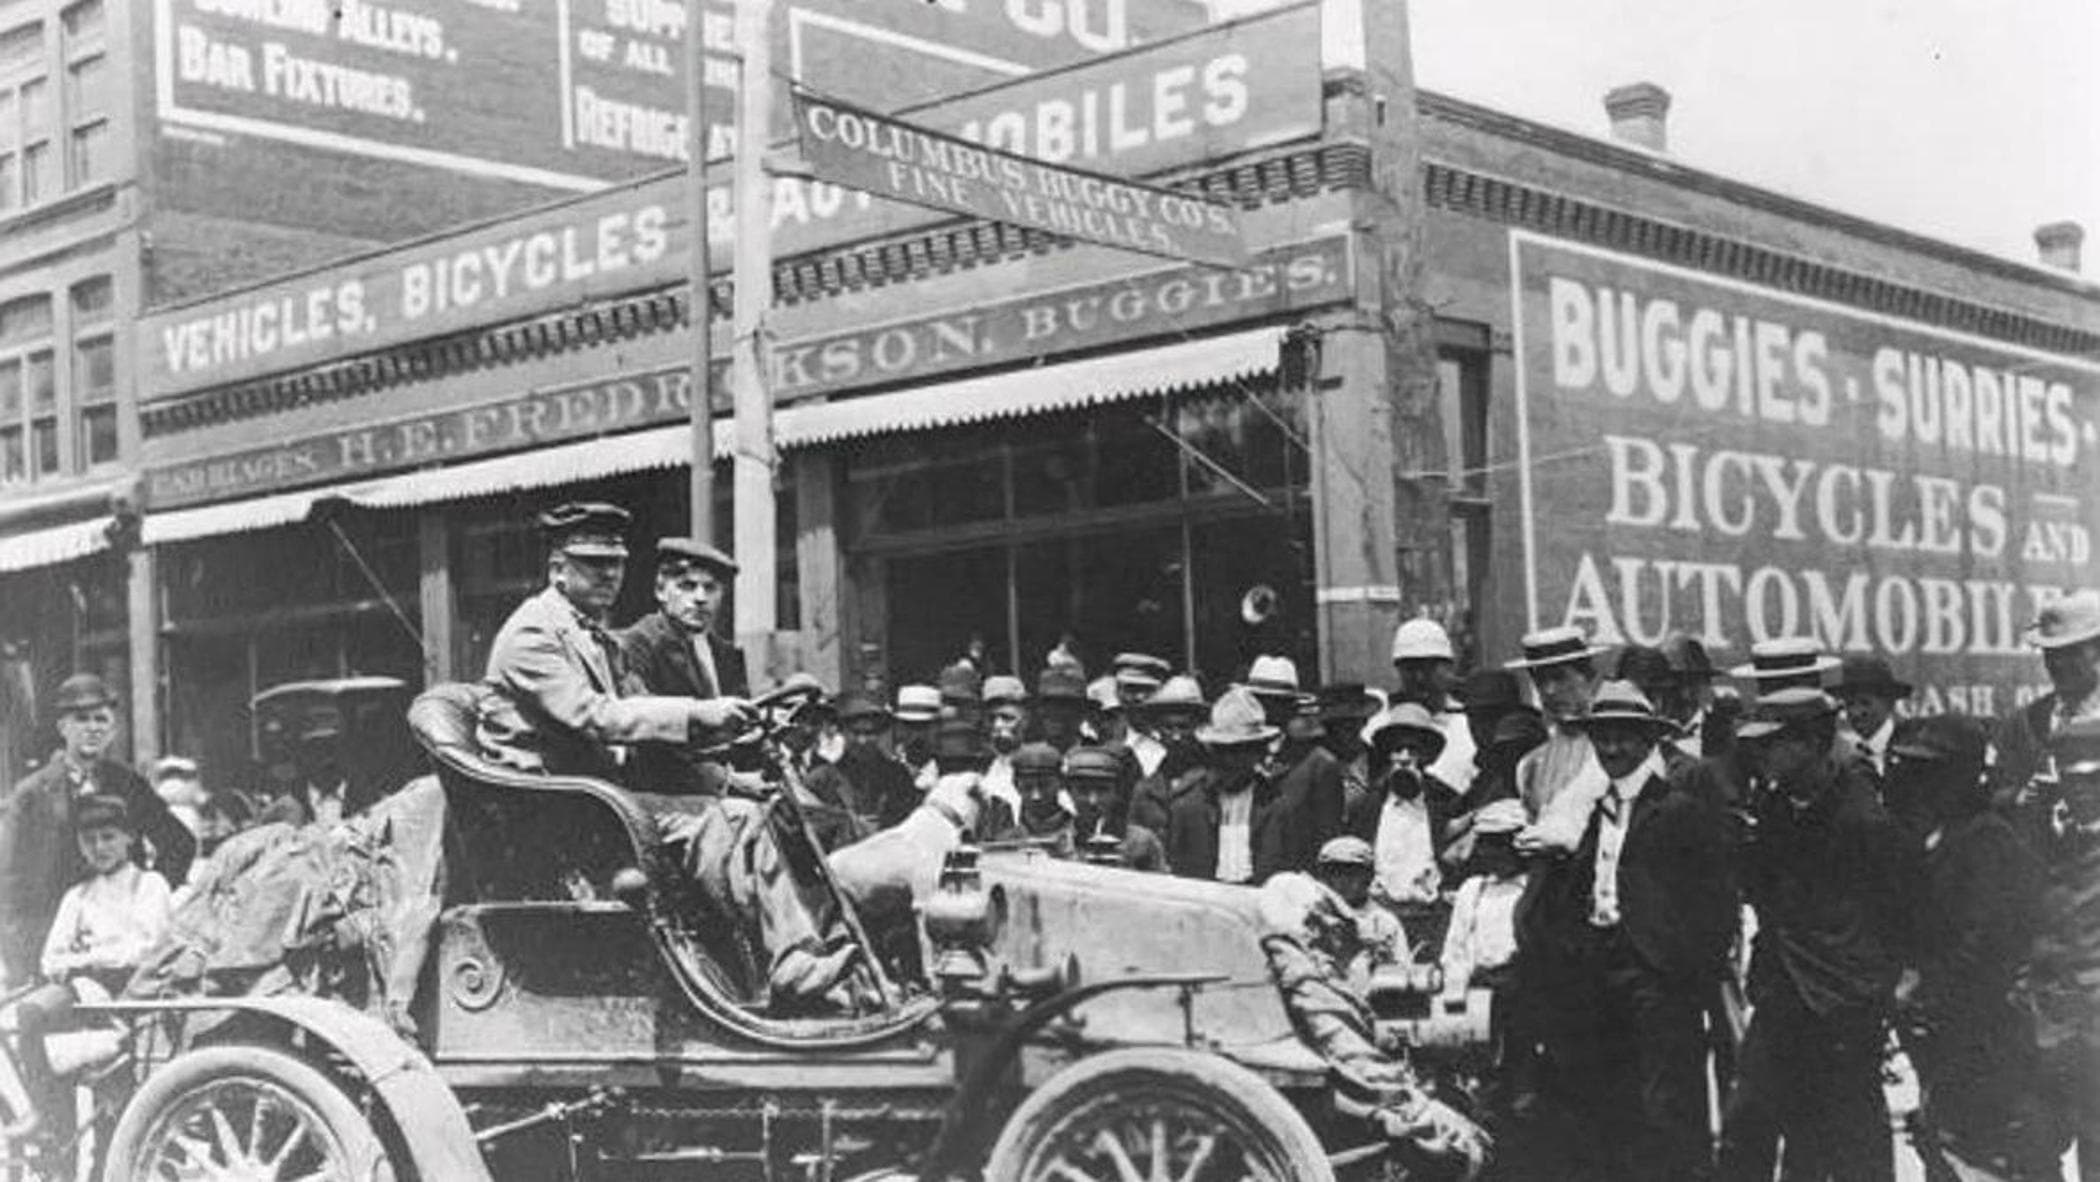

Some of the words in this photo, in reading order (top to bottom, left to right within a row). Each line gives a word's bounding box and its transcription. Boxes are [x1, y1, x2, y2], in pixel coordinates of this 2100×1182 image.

[178, 25, 256, 93] BAR
[262, 42, 426, 124] FIXTURES.
[625, 40, 675, 77] ALL
[808, 105, 1027, 191] COLUMBUS
[1036, 168, 1150, 219] BUGGY
[887, 159, 967, 207] FINE
[402, 204, 667, 320] BICYCLES
[1022, 254, 1338, 340] BUGGIES.
[1604, 435, 2007, 557] BICYCLES
[2023, 520, 2090, 564] AND
